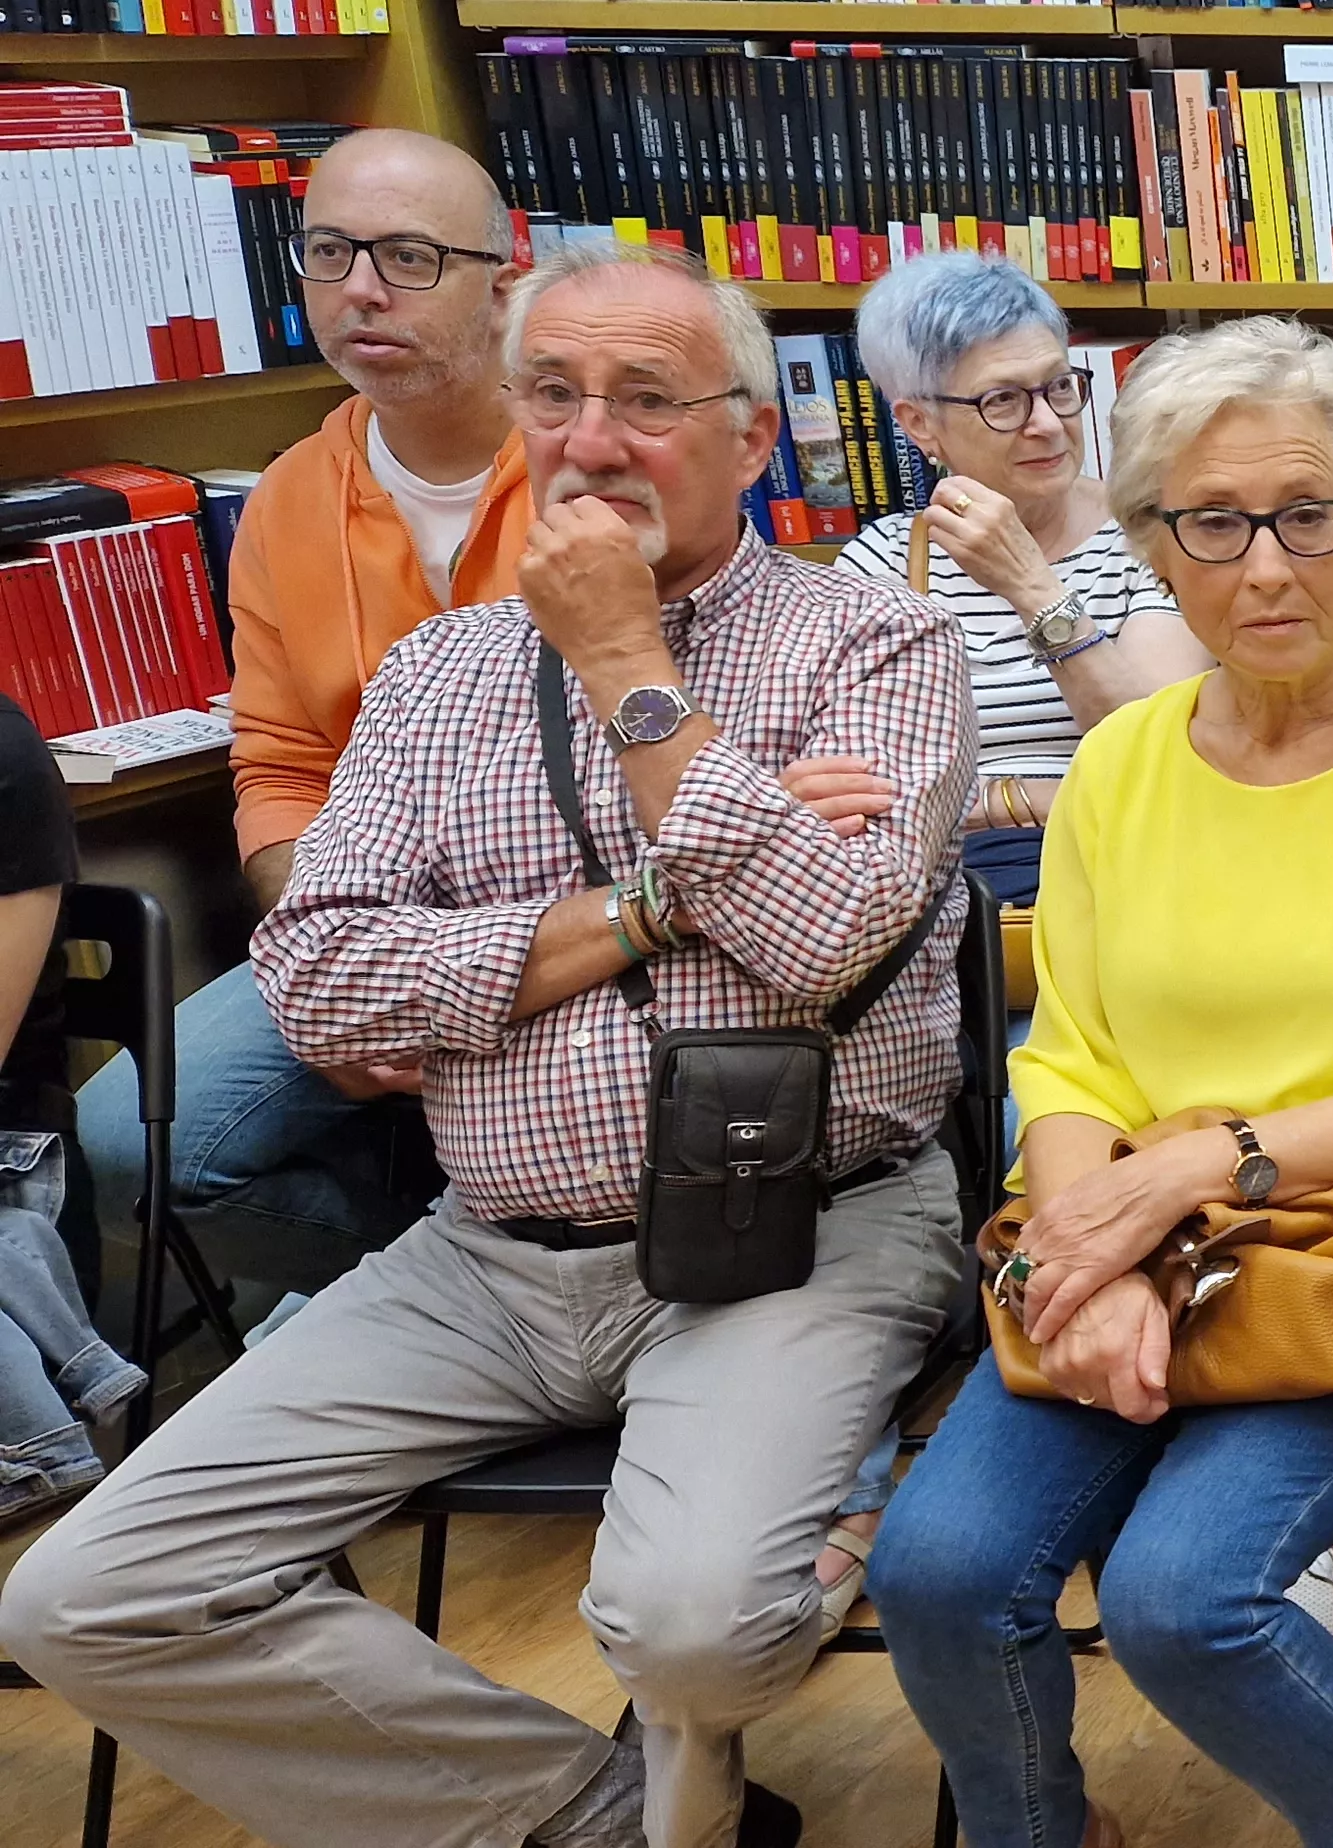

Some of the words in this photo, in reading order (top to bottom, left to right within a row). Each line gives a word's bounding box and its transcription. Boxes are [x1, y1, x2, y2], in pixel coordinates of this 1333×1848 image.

[1186, 97, 1197, 136] Maxwell
[834, 379, 854, 426] PÁJARO
[857, 379, 877, 426] PÁJARO
[844, 440, 868, 504] CARNICERO
[866, 441, 889, 505] CARNICERO
[907, 447, 928, 507] FERNANDO
[901, 489, 917, 511] LOS
[182, 552, 193, 570] DOM
[188, 571, 199, 594] PARA
[193, 595, 204, 623] HOGAR
[197, 624, 207, 636] UN
